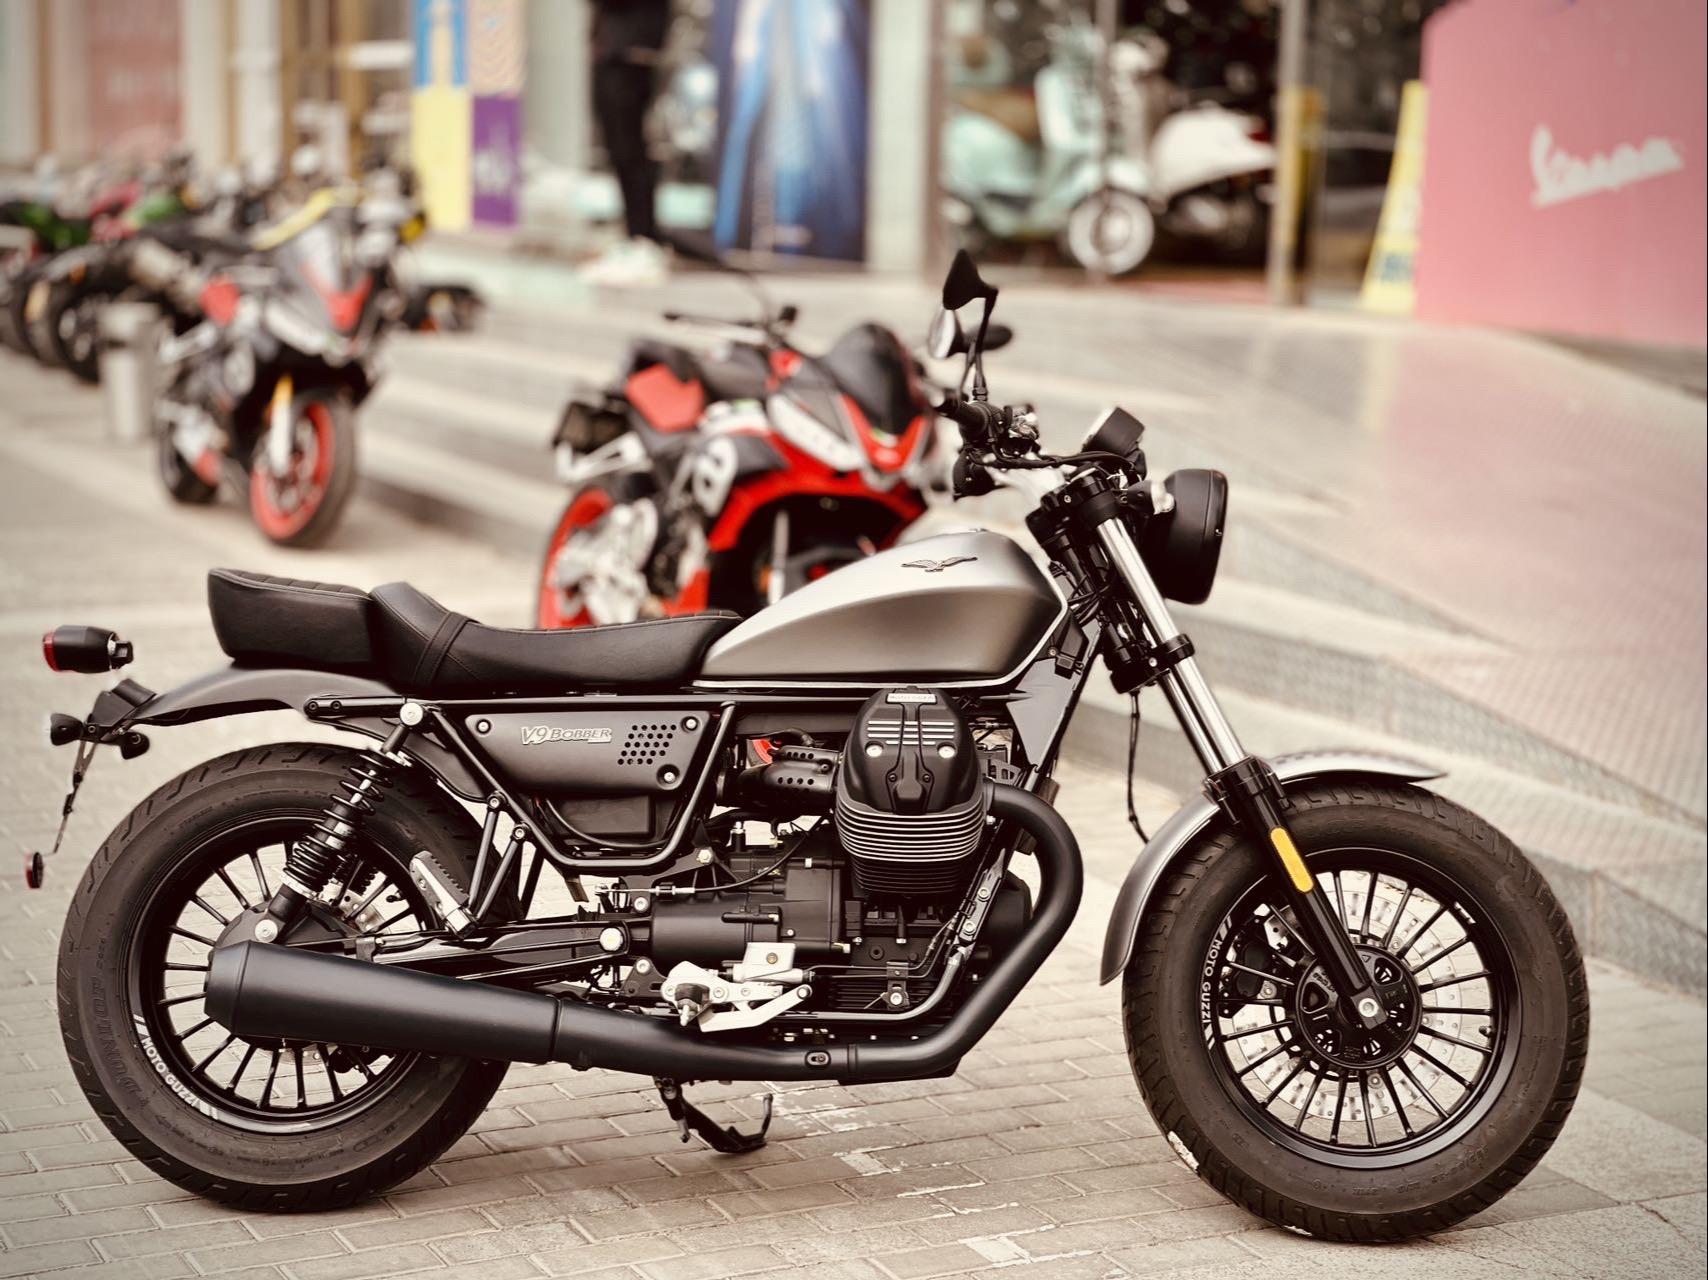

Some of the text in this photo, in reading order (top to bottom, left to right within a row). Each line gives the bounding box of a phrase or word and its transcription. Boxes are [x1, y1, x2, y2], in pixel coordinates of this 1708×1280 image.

[521, 726, 612, 745] V9 BOBBER
[1201, 939, 1223, 1024] MOTO GUZZI
[141, 1037, 201, 1108] MOTO GUZZI
